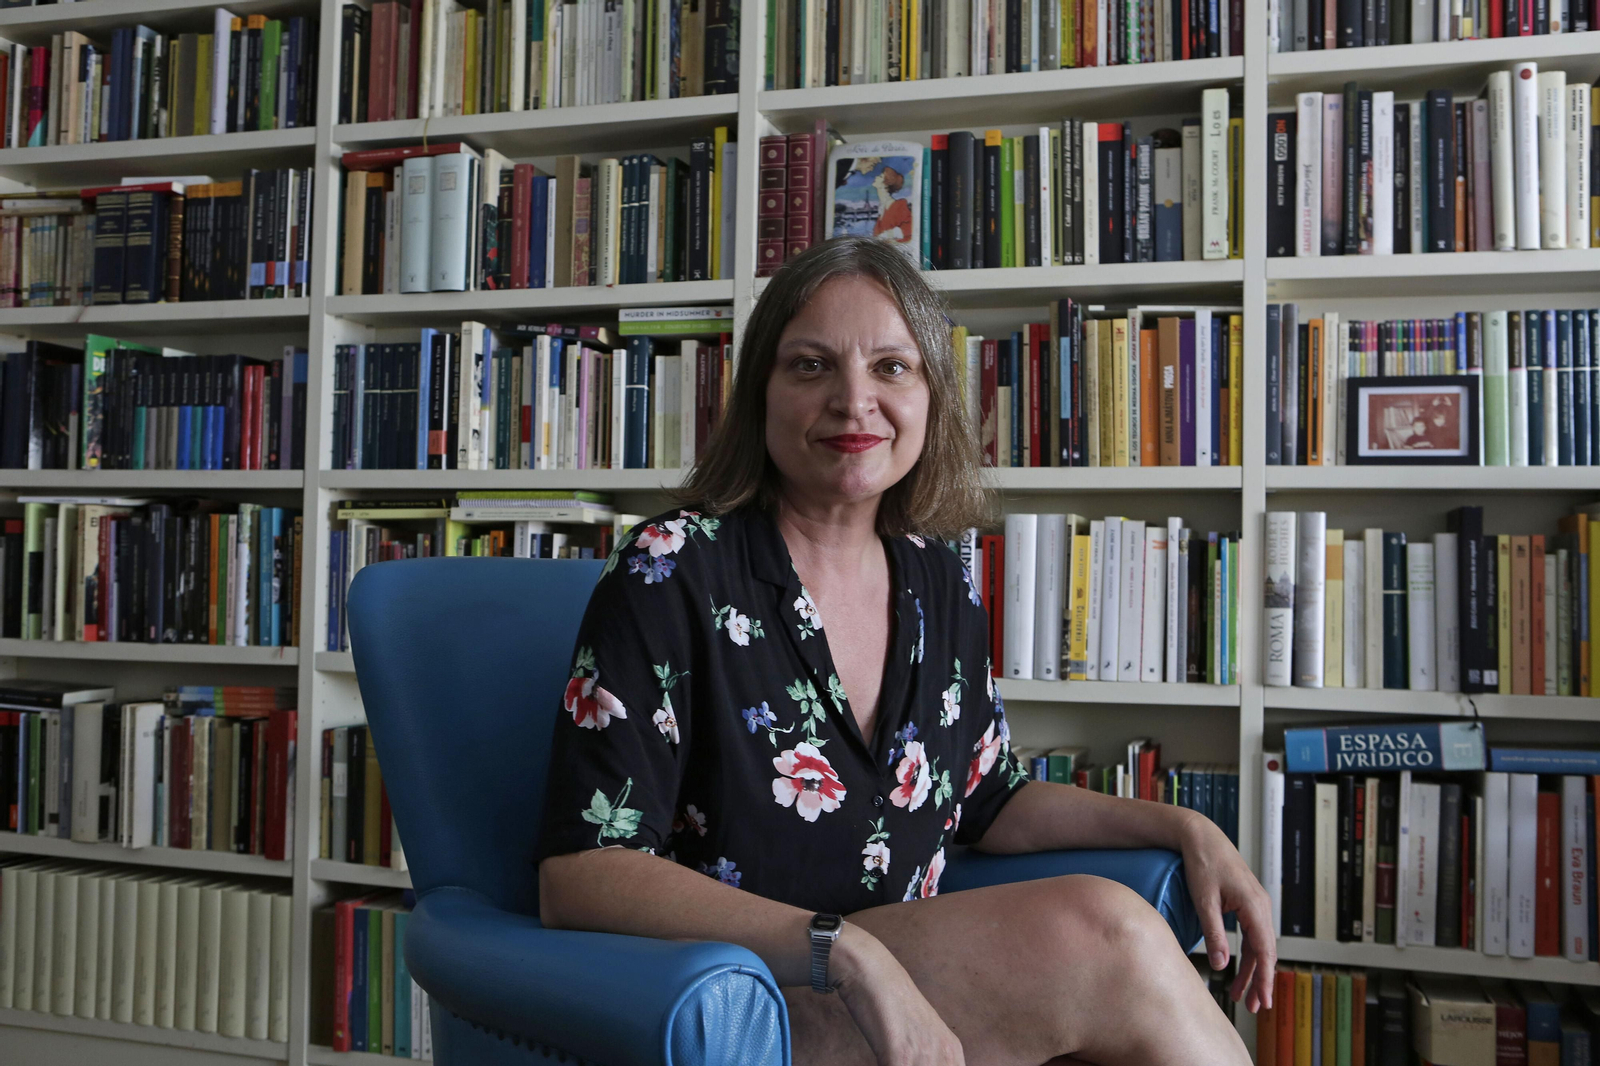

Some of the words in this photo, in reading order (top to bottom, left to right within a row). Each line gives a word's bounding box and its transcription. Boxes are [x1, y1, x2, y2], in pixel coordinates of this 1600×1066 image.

[1276, 119, 1287, 133] NO
[1275, 133, 1287, 160] LOGO
[1138, 144, 1151, 180] Estambul
[1303, 164, 1313, 179] John
[1137, 184, 1150, 212] PAMUK
[1210, 191, 1220, 216] FRANK
[1303, 179, 1313, 207] Grisham
[1303, 208, 1312, 217] EL
[1137, 213, 1150, 240] ORHAN
[1303, 219, 1312, 253] CLIENTE
[624, 311, 654, 319] MURDER
[666, 309, 711, 317] MIDSUMMER
[1163, 365, 1174, 389] PROSA
[1162, 390, 1174, 424] AJMÁTOVA
[1165, 425, 1174, 444] ANNA
[1266, 521, 1277, 566] ROBERT
[1278, 519, 1289, 566] HUGHES
[1075, 605, 1084, 642] CALIFORNIA
[1268, 614, 1284, 663] ROMA
[1339, 733, 1427, 752] ESPASA
[1571, 847, 1583, 868] Eva
[1571, 870, 1584, 906] Braun
[1440, 1013, 1493, 1025] LAROUSSE
